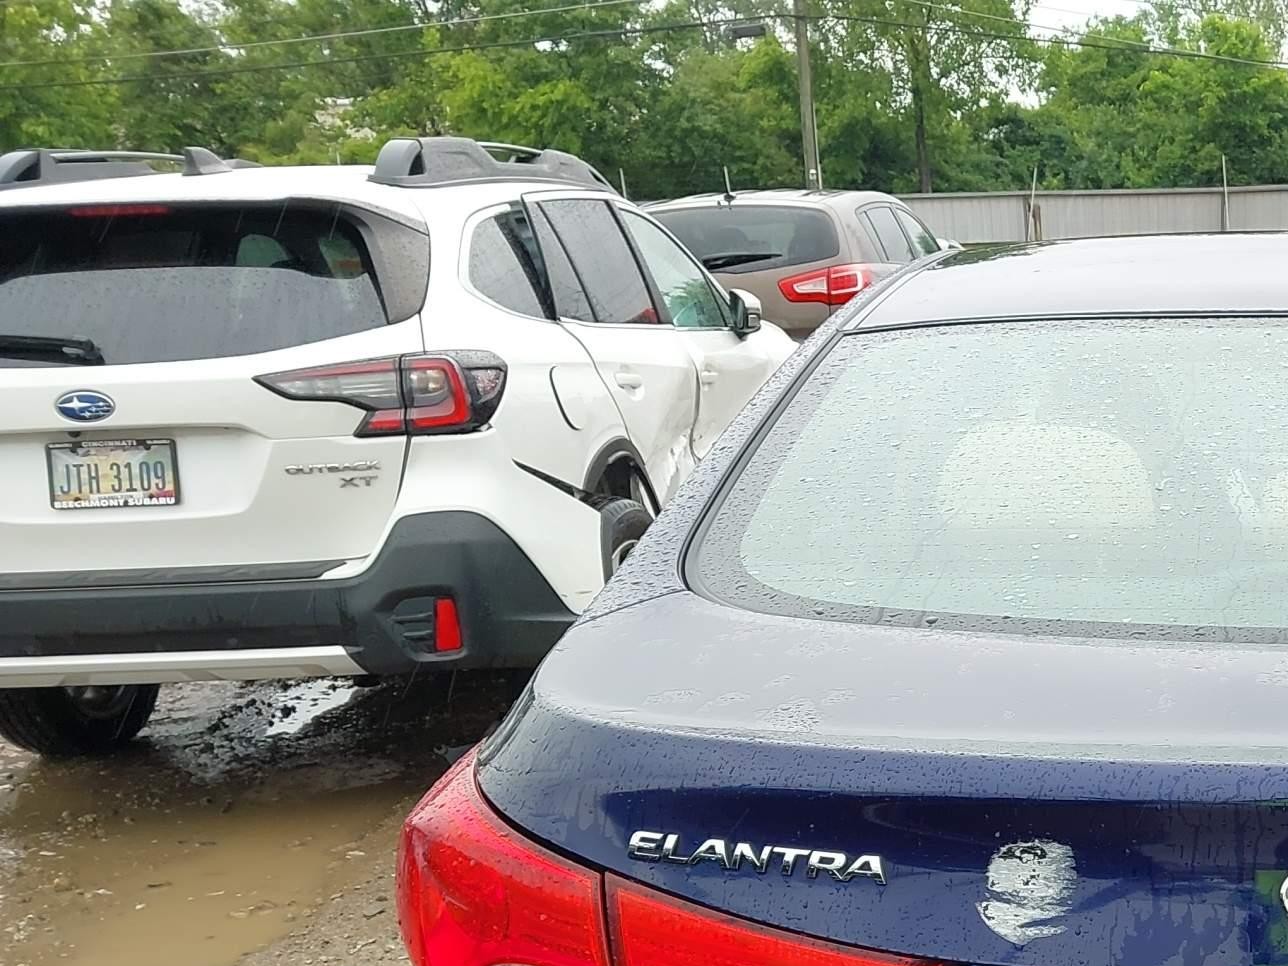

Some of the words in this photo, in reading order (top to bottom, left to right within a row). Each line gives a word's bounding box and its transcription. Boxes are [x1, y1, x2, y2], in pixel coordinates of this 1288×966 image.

[81, 439, 137, 448] CINCINNATI
[284, 460, 381, 475] OUTBACK
[59, 462, 101, 495] JTH
[109, 460, 166, 493] 3109
[339, 475, 378, 488] XT
[127, 496, 176, 507] SUBARU
[627, 830, 888, 885] ELANTRA
